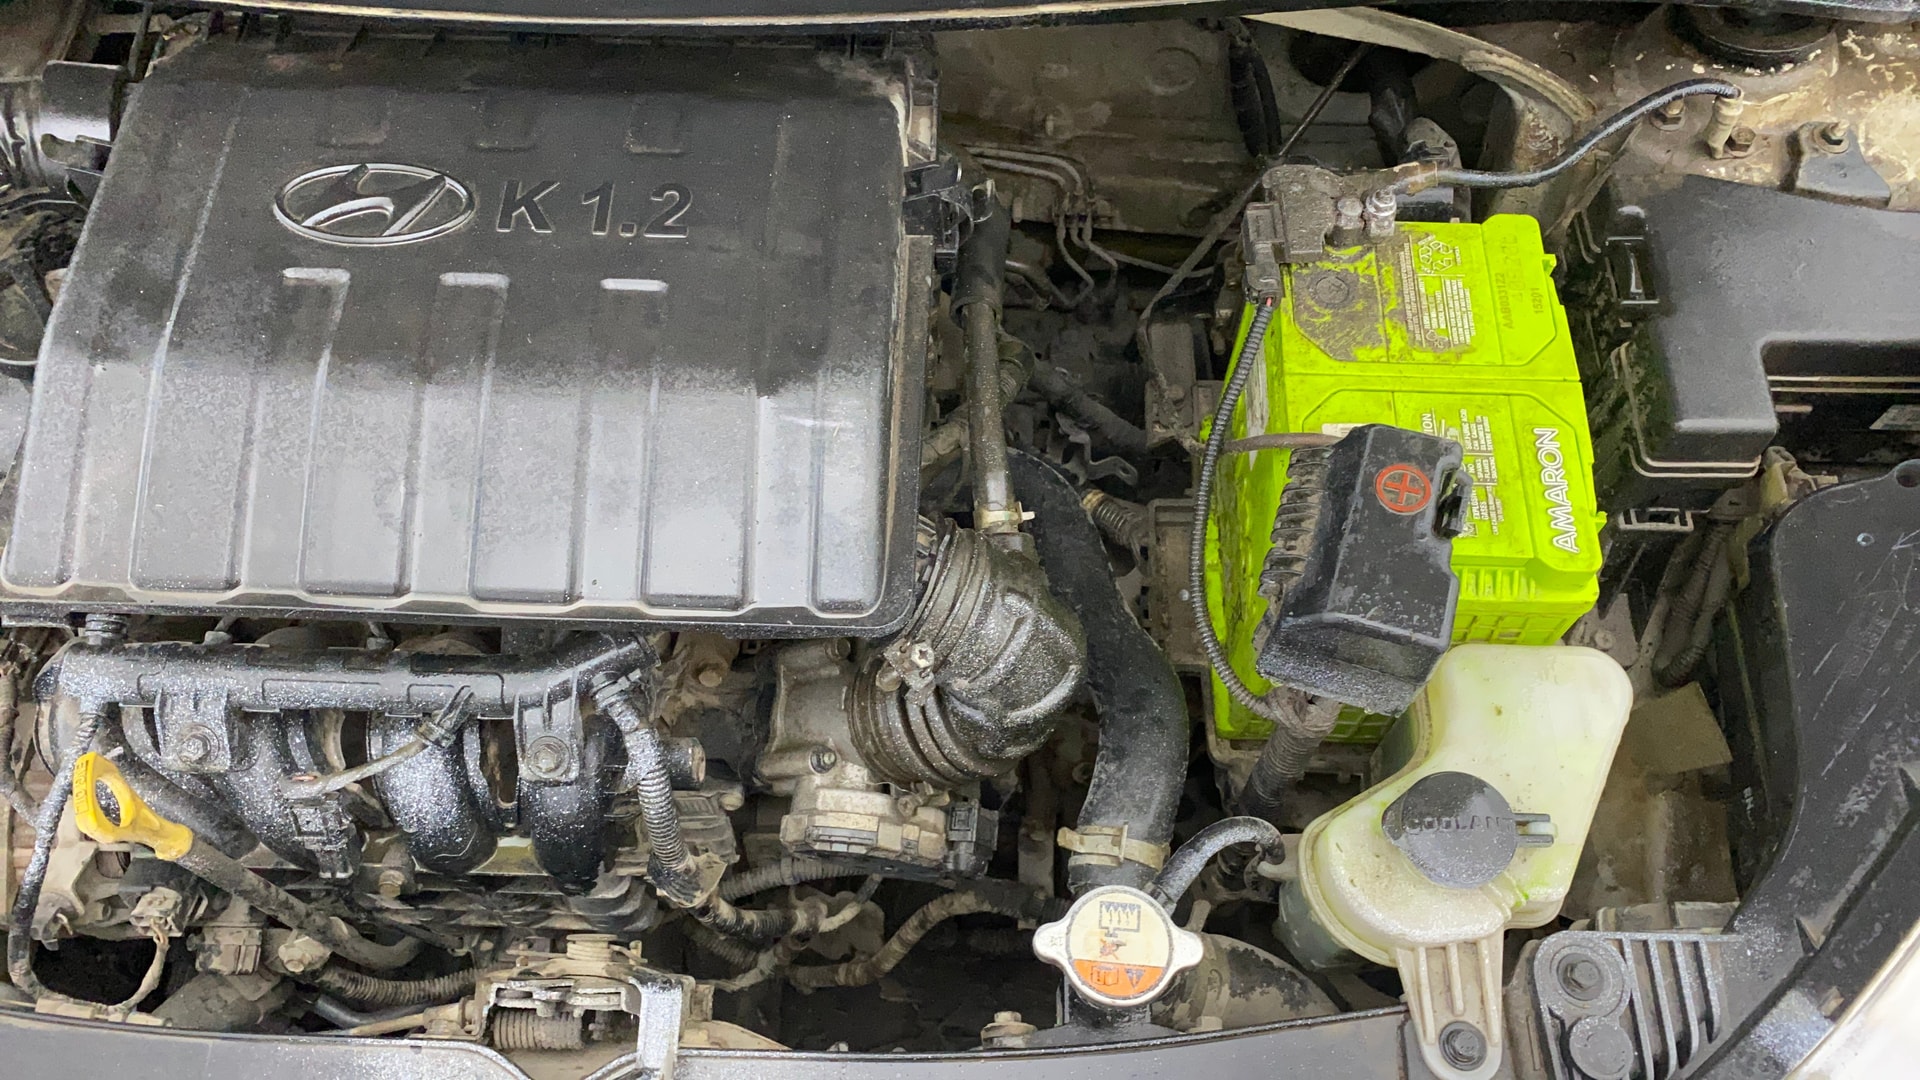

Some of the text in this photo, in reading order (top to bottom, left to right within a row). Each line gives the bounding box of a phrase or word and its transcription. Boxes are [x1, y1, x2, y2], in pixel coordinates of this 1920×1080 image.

[496, 179, 693, 239] K 1.2
[1468, 464, 1475, 474] NO
[1532, 427, 1580, 555] AMARON
[1404, 815, 1512, 834] COOLANT
